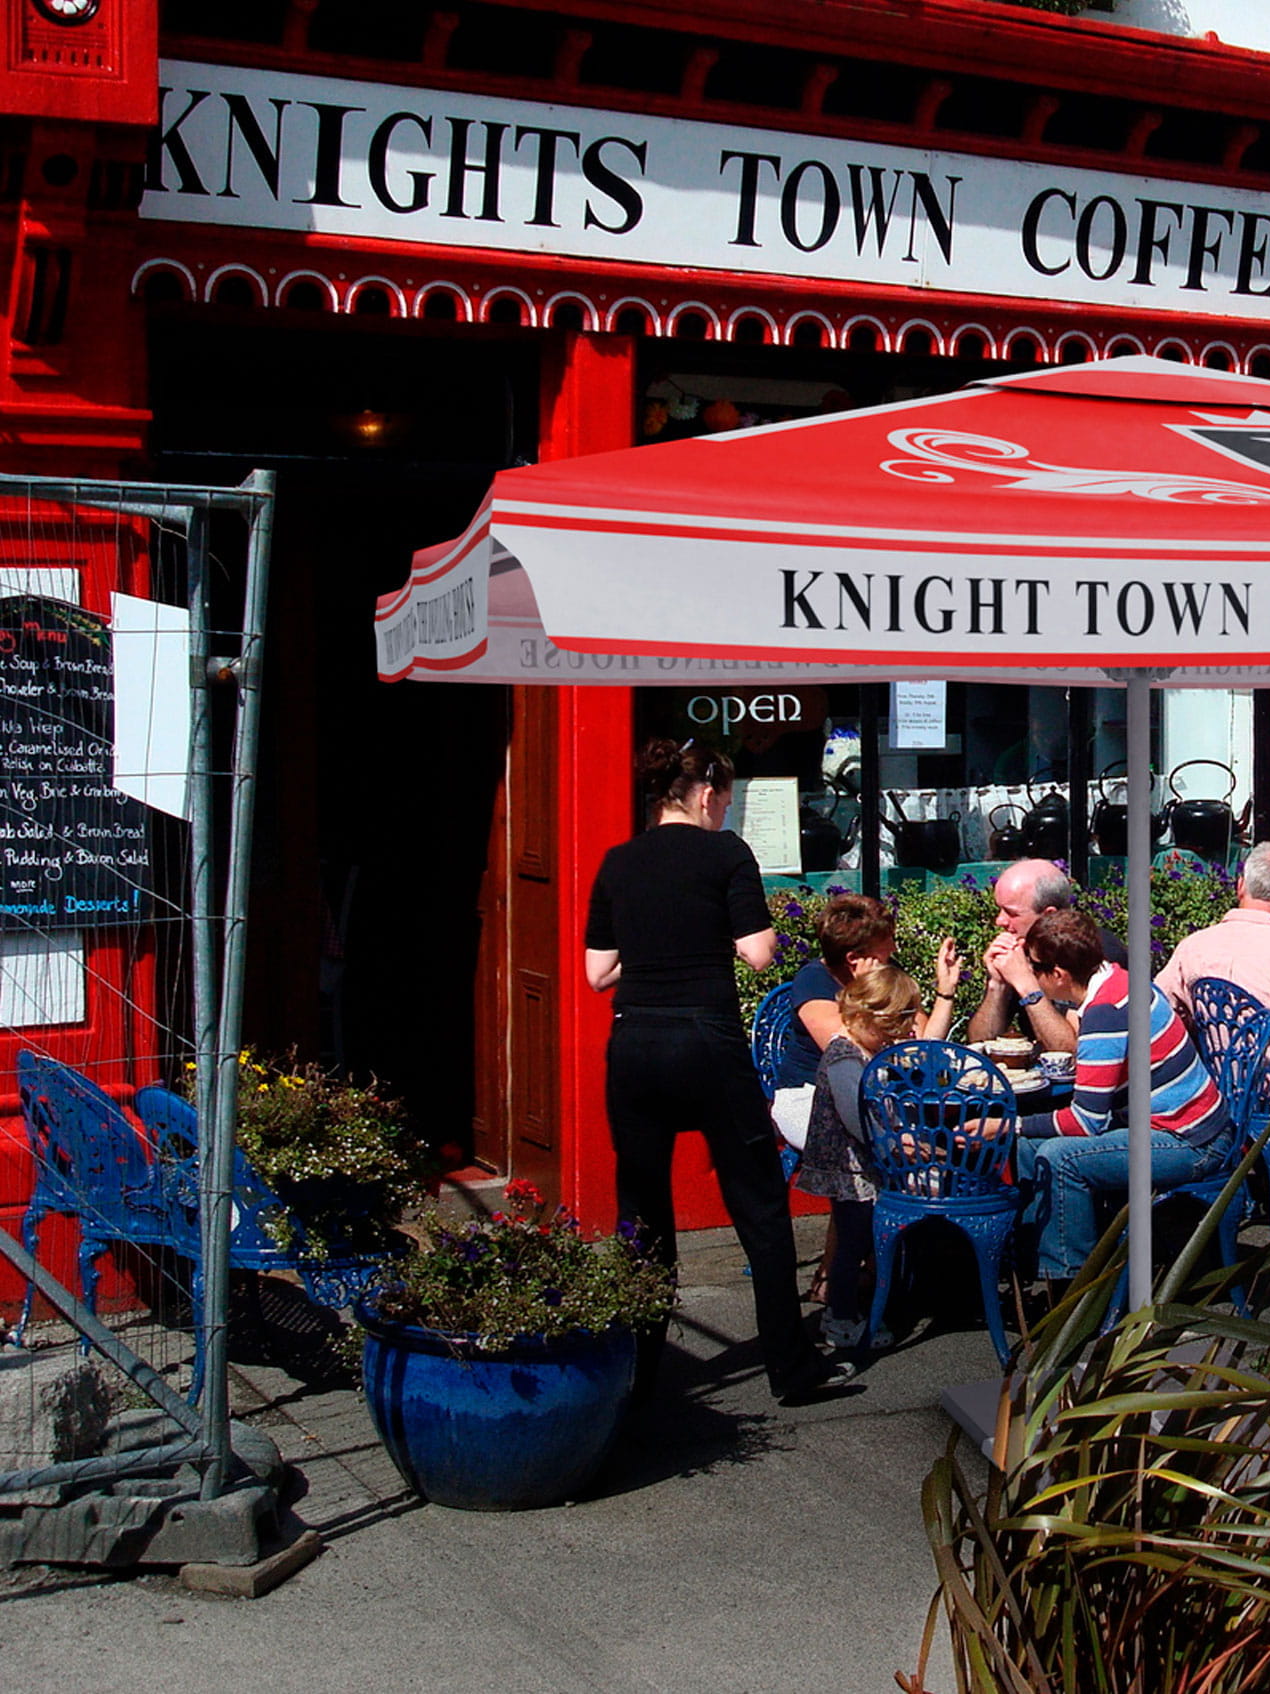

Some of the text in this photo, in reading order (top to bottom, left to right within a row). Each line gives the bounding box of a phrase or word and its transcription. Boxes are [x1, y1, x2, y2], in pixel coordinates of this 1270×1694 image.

[145, 86, 648, 236] KNIGHTS
[720, 150, 964, 266] TOWN
[777, 568, 1051, 636] KNIGHT
[1075, 580, 1253, 637] TOWN
[10, 654, 38, 675] Soup
[8, 739, 84, 757] Caramelised
[38, 762, 53, 771] on
[40, 781, 68, 800] Brie
[16, 821, 54, 840] Salad
[4, 847, 63, 881] Pudding
[75, 849, 114, 865] Bacon
[116, 848, 149, 866] Salad
